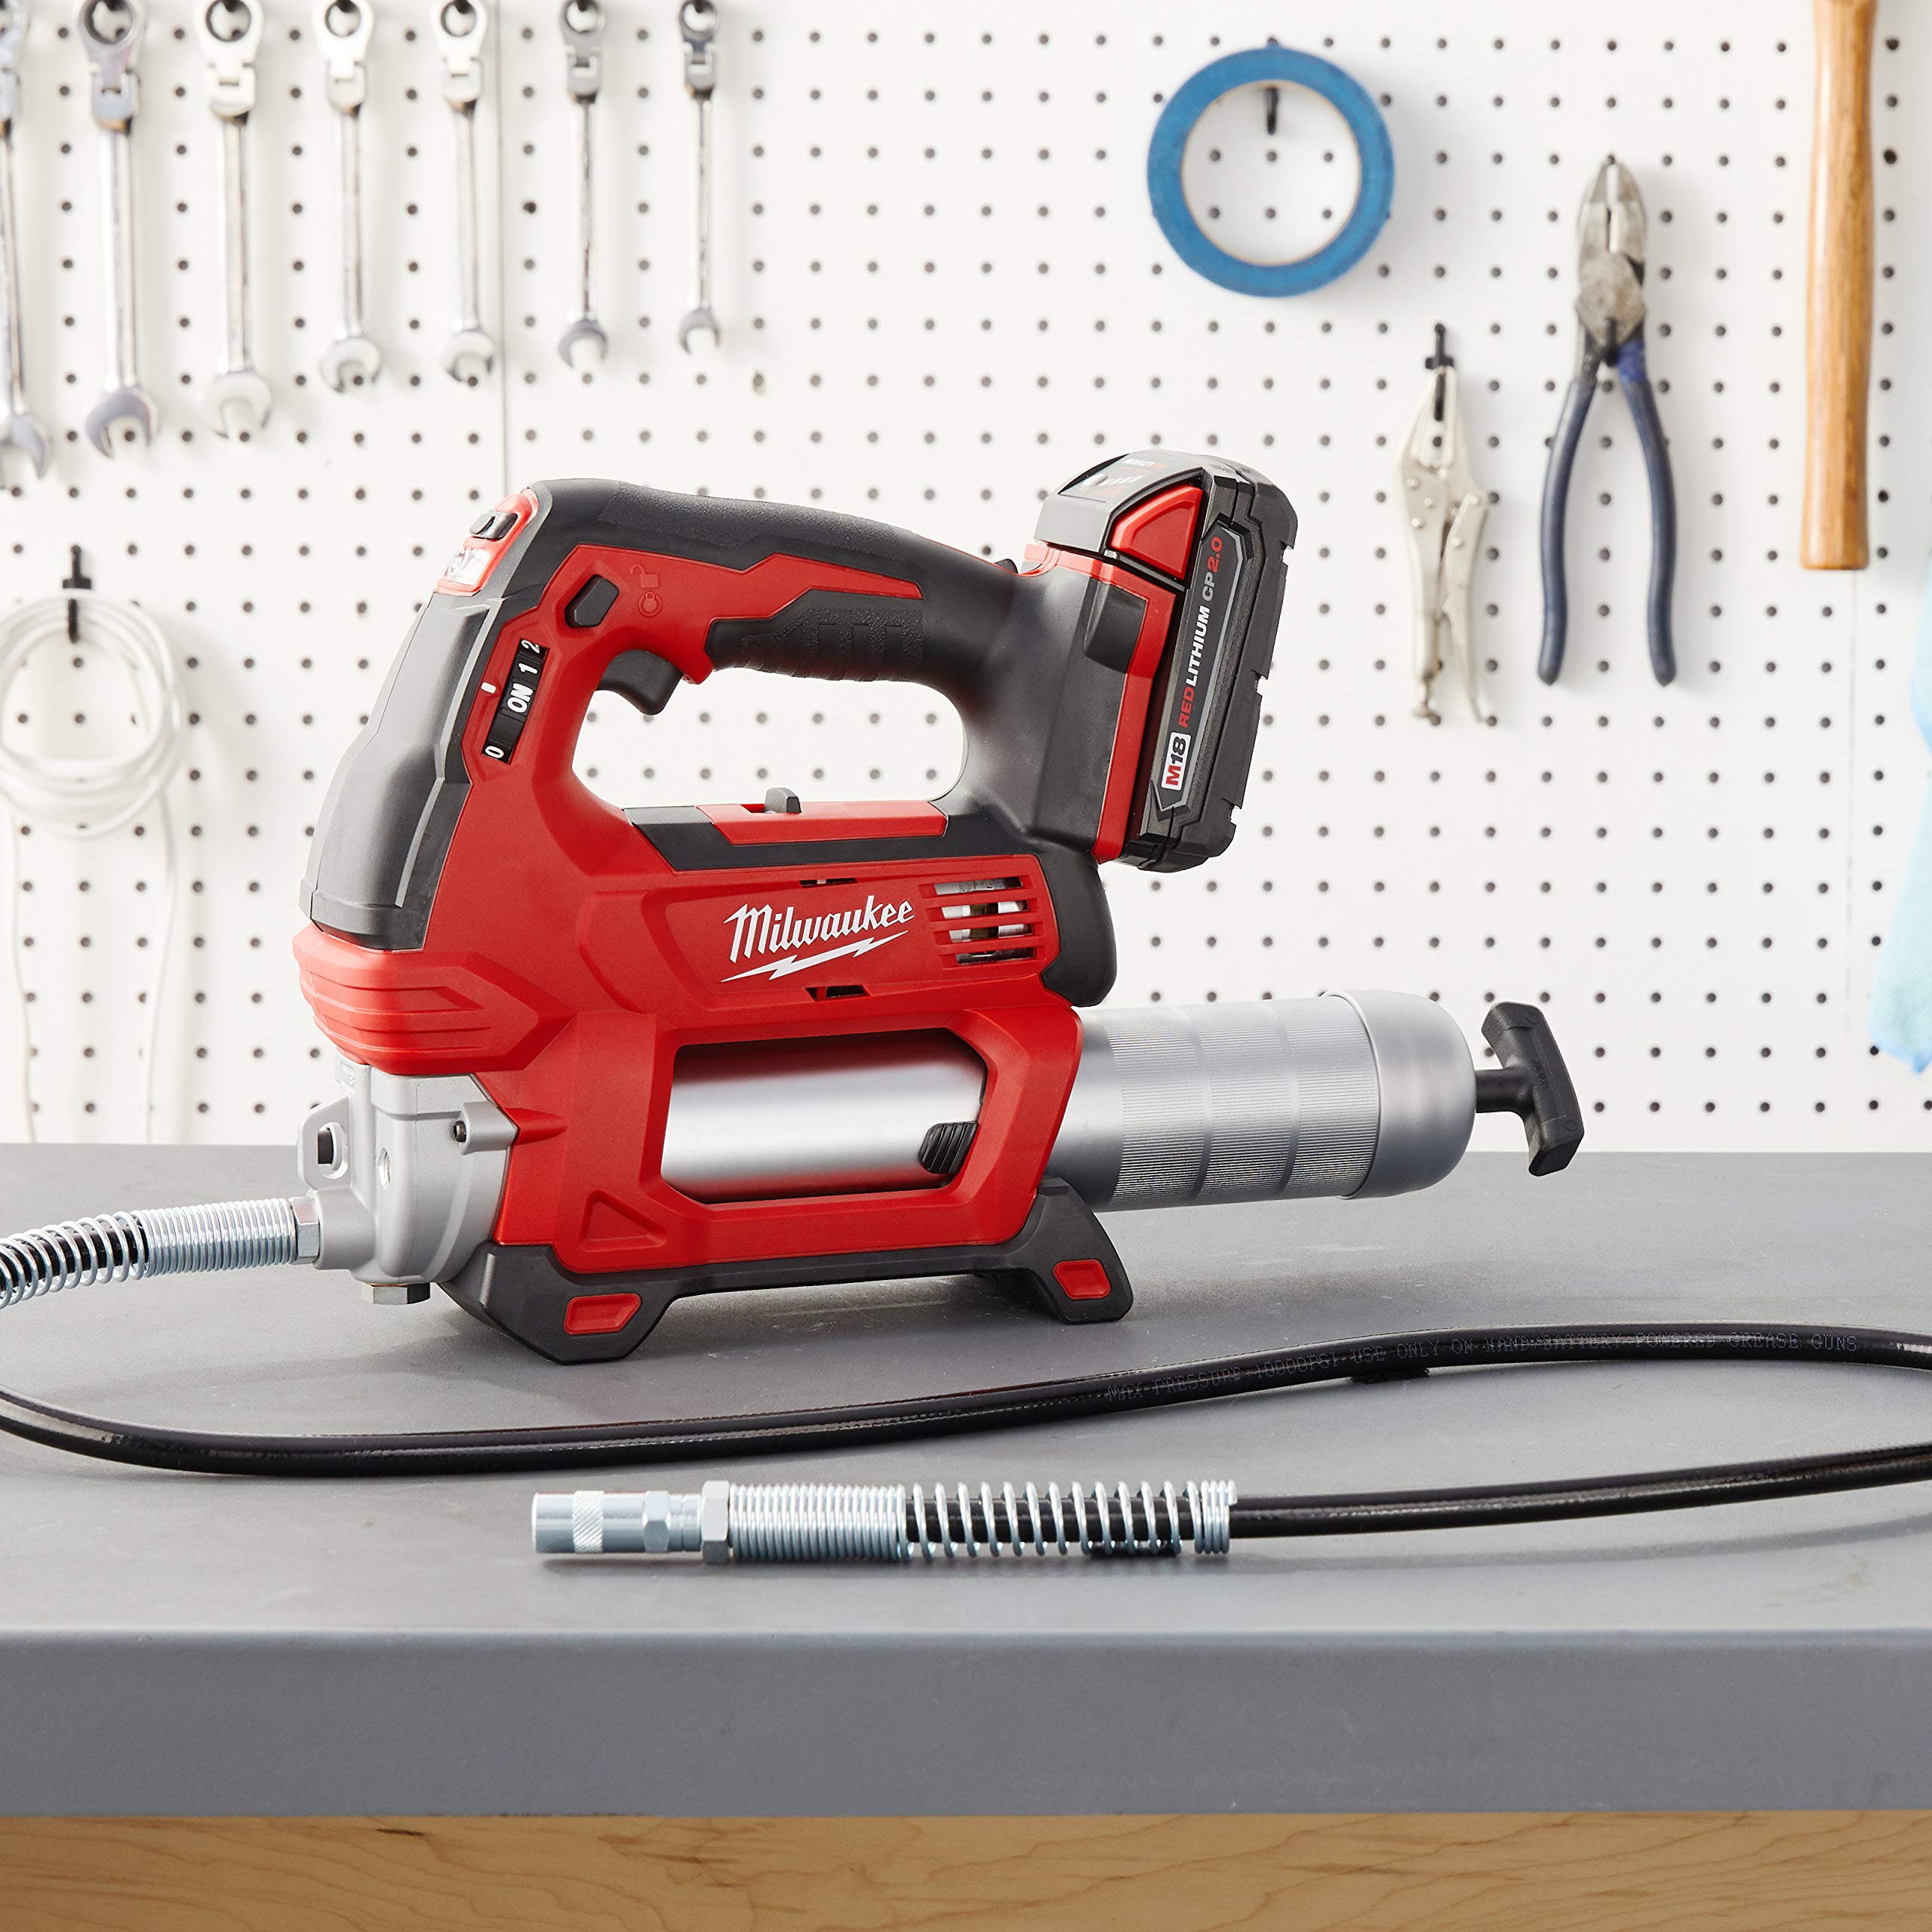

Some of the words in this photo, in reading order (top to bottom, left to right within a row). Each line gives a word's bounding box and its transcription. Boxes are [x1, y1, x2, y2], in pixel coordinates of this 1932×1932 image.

[521, 638, 540, 654] 2
[518, 663, 539, 675] 1
[507, 683, 534, 713] ON
[485, 745, 504, 758] 0
[1166, 736, 1186, 786] M18
[723, 895, 915, 963] Milwaukee
[1107, 1382, 1143, 1401] MAX
[1350, 1346, 1386, 1364] USE
[1397, 1340, 1439, 1358] ONLY
[1451, 1338, 1474, 1355] ON
[1727, 1332, 1800, 1349] GREASE
[1810, 1334, 1857, 1352] GUNS
